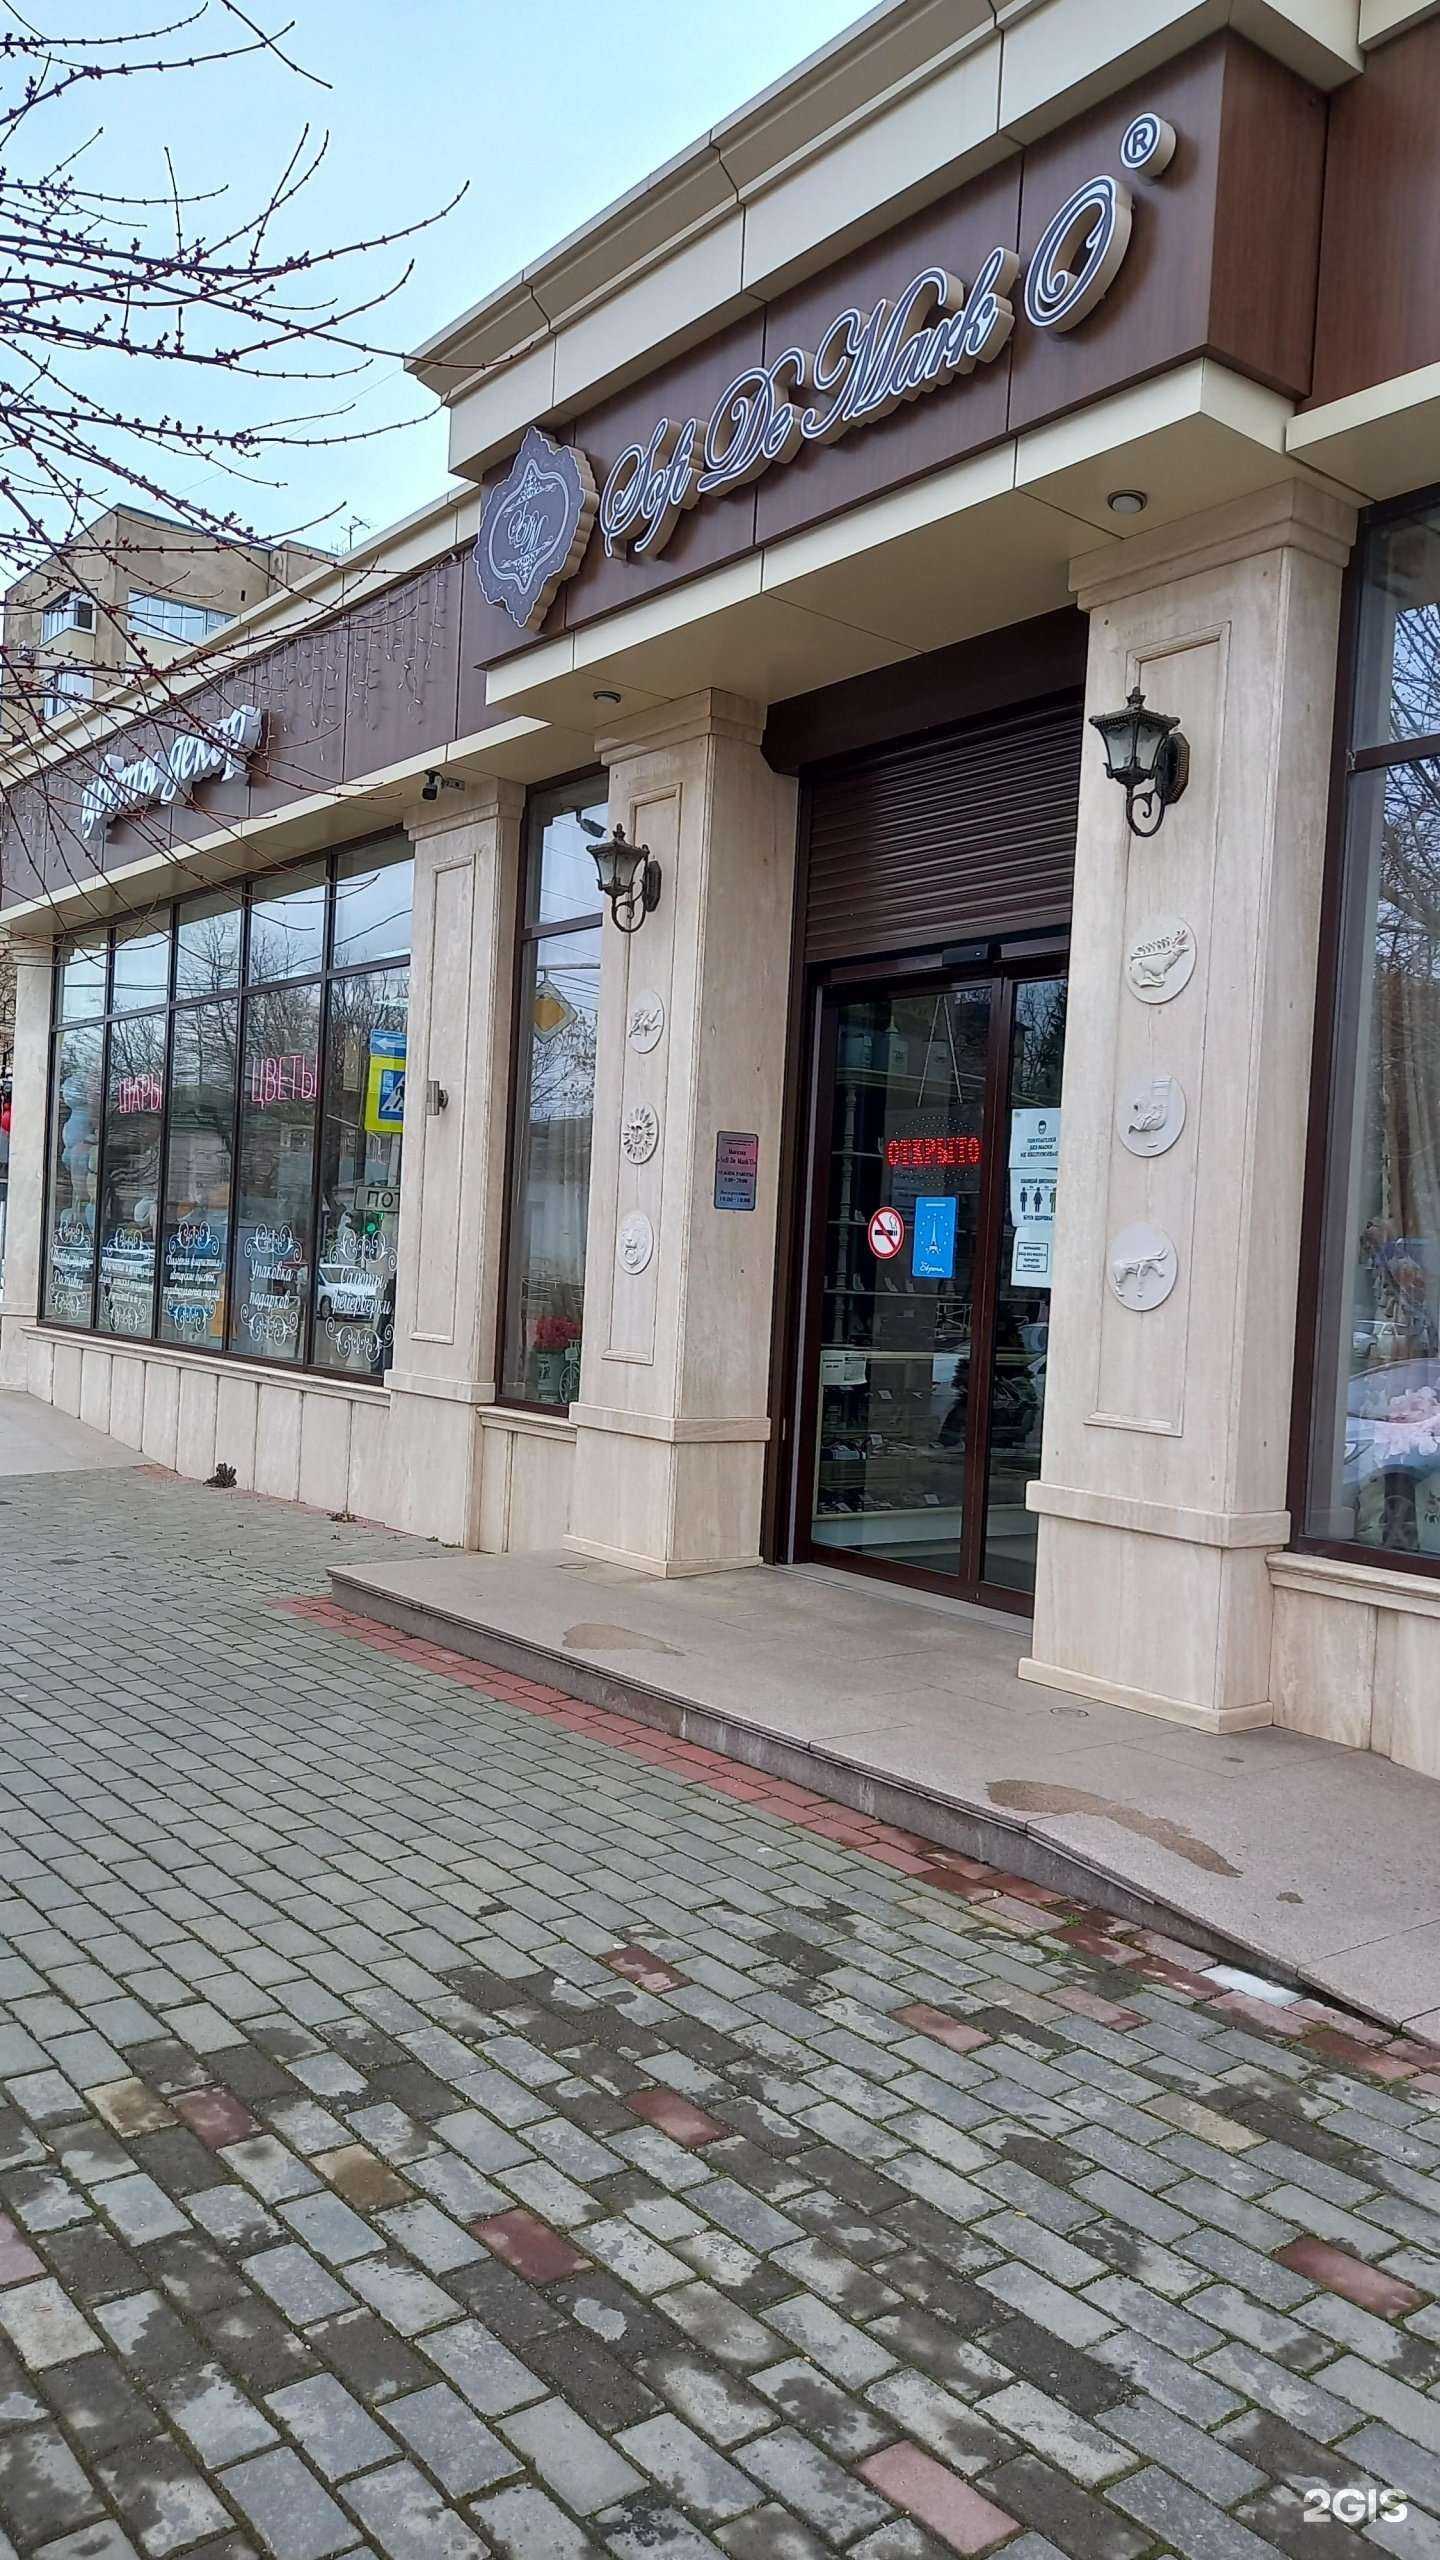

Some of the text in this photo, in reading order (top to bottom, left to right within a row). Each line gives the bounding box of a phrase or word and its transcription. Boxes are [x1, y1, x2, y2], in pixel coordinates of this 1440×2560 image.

[698, 346, 805, 492] De
[801, 247, 1005, 439] Mark
[119, 1071, 163, 1113] ШАРЫ
[252, 1055, 317, 1109] ЦВЕТЫ
[887, 1136, 982, 1166] ОТКРЫТО
[250, 1260, 292, 1281] Упаковка
[249, 1290, 291, 1313] подарков
